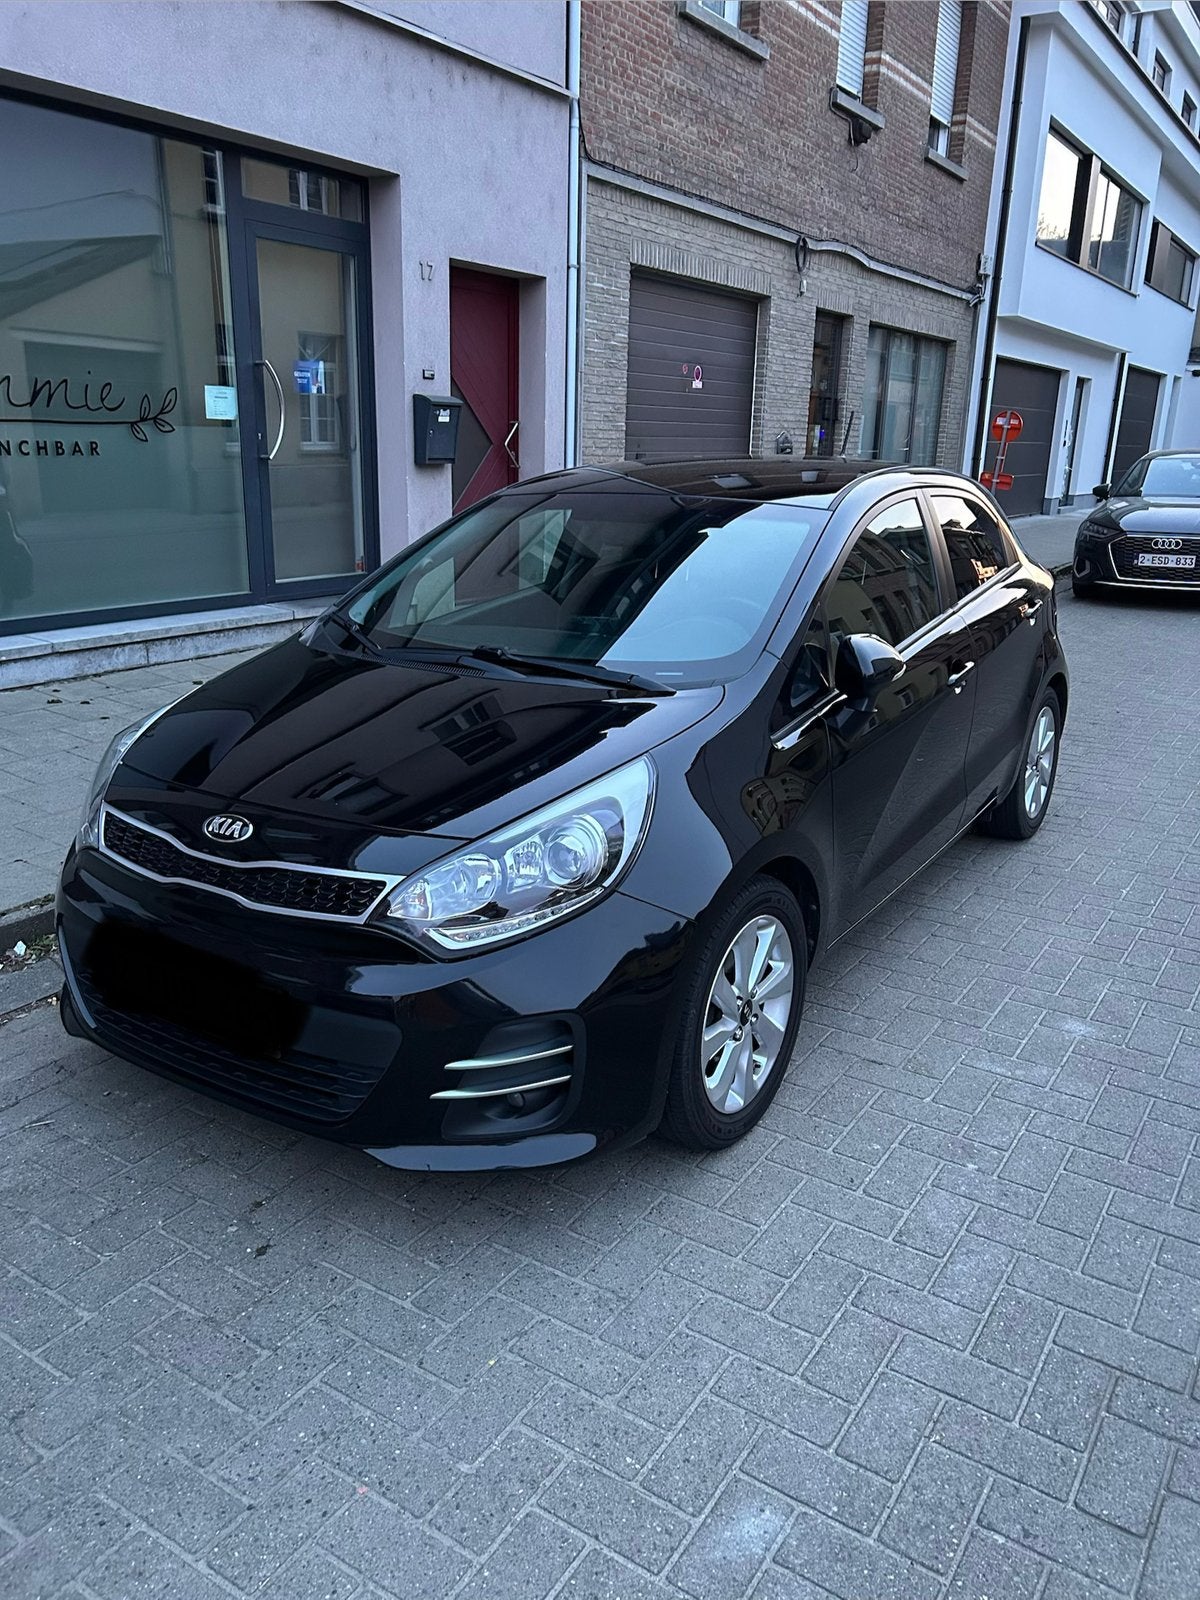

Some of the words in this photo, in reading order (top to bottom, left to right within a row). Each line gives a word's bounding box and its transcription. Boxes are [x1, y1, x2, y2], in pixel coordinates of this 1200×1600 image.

[418, 260, 434, 282] 17
[0, 439, 101, 457] NCHBAR
[208, 816, 244, 839] KIA
